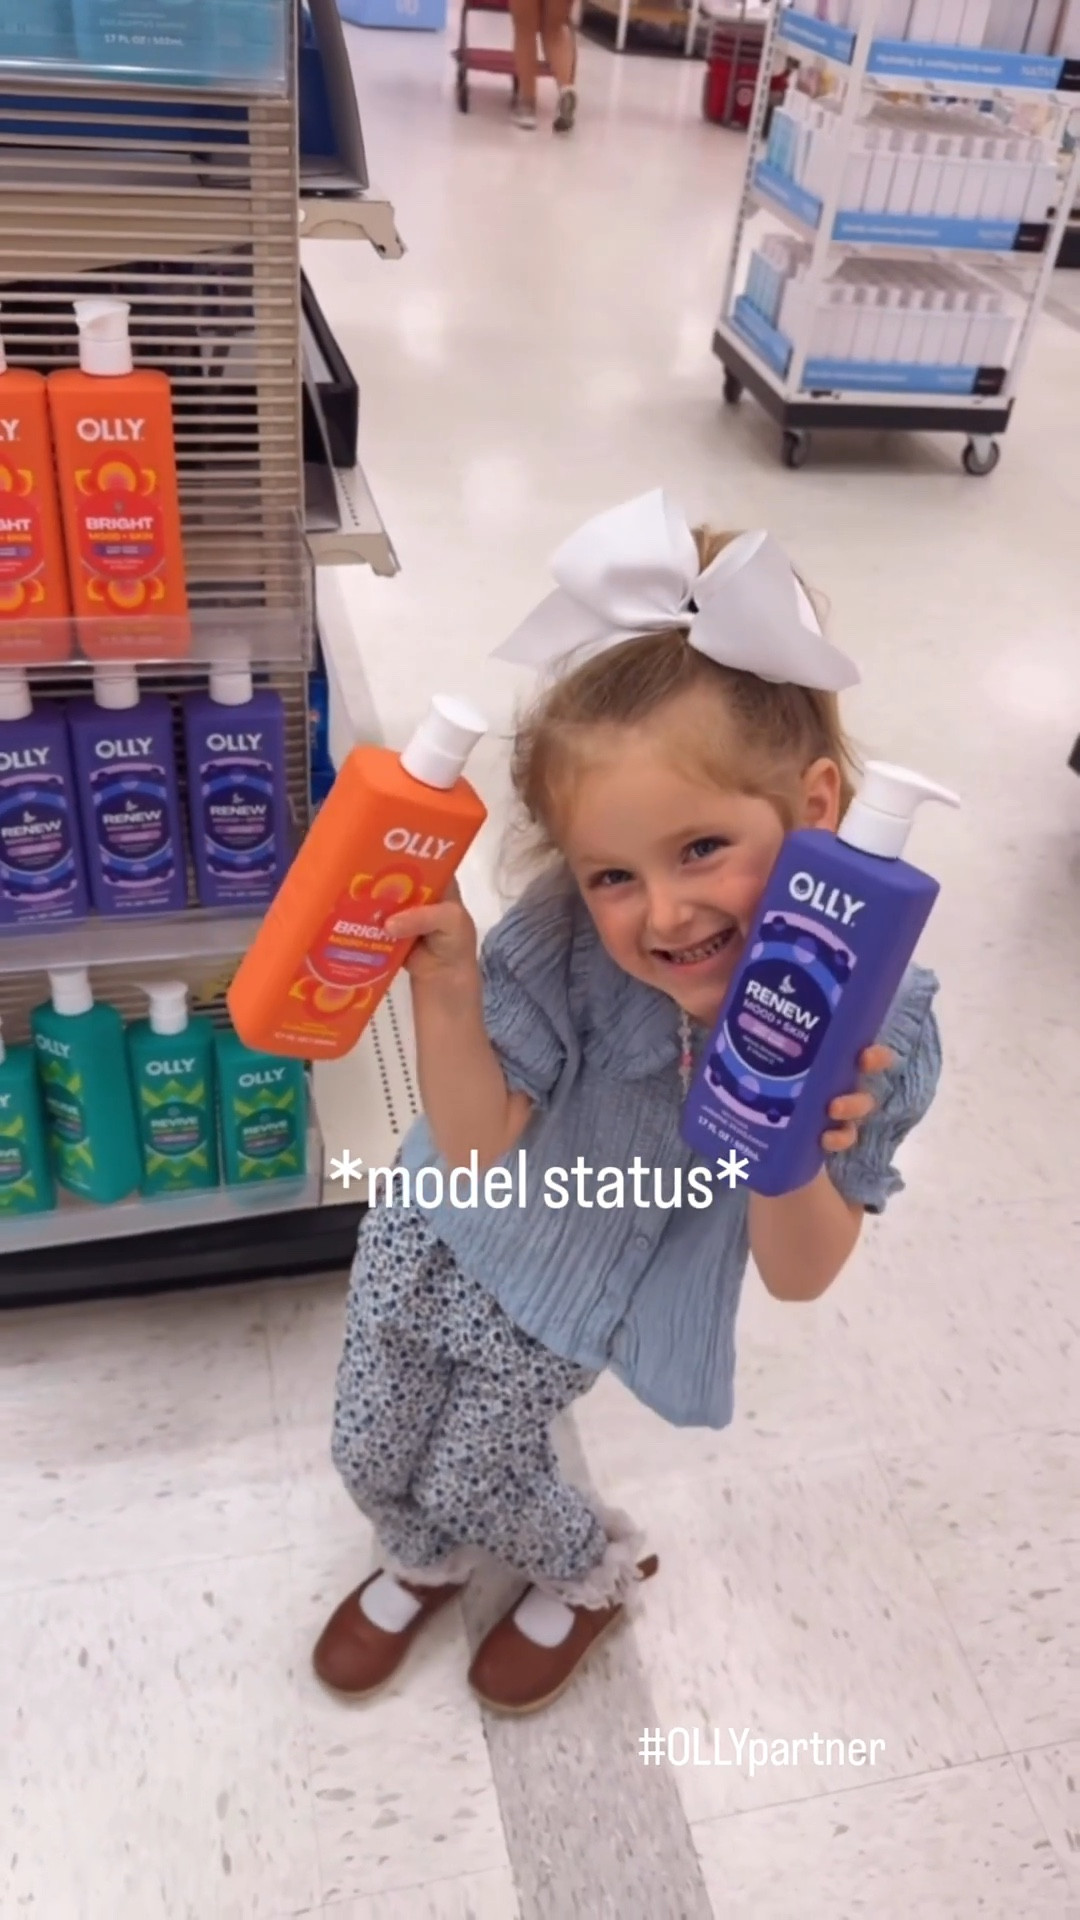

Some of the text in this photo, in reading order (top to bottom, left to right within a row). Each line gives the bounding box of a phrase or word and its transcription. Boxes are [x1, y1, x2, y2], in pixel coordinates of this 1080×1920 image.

[76, 418, 146, 441] OLLY
[0, 518, 32, 531] GHT
[85, 516, 154, 531] BRIGHT
[95, 737, 154, 760] OLLY
[206, 733, 263, 752] OLLY
[0, 747, 50, 772] OLLY
[102, 810, 163, 825] RENEW
[209, 805, 268, 816] RENEW
[1, 820, 63, 838] RENEW
[383, 827, 455, 861] OLLY
[788, 871, 866, 926] OLLY
[745, 979, 820, 1030] RENEW
[742, 998, 776, 1024] MOOD
[782, 1020, 810, 1044] SKIN
[36, 1033, 71, 1059] OLLY
[146, 1058, 196, 1076] OLLY
[239, 1067, 286, 1088] OLLY
[150, 1116, 199, 1128] REVIVE
